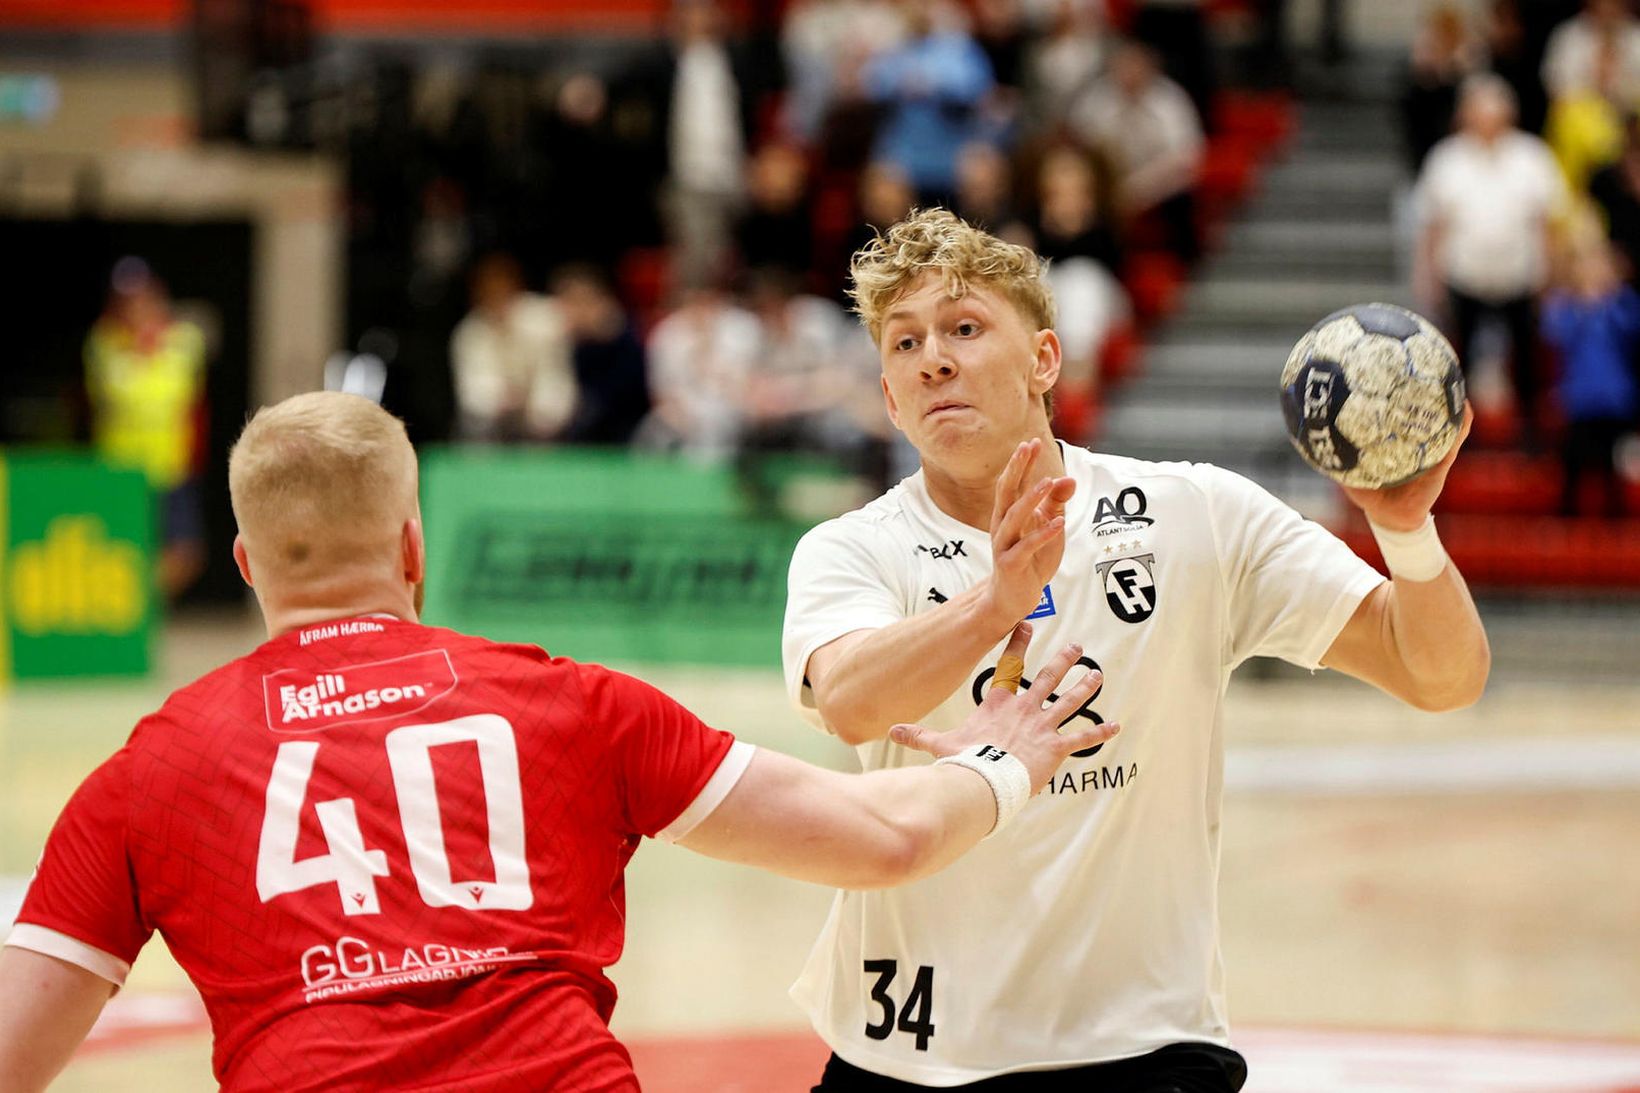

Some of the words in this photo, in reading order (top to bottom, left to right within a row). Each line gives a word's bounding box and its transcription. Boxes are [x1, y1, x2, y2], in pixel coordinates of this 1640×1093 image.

[279, 674, 346, 707] Egill
[1047, 762, 1138, 795] HARMA
[256, 713, 534, 917] 40
[863, 958, 936, 1052] 34
